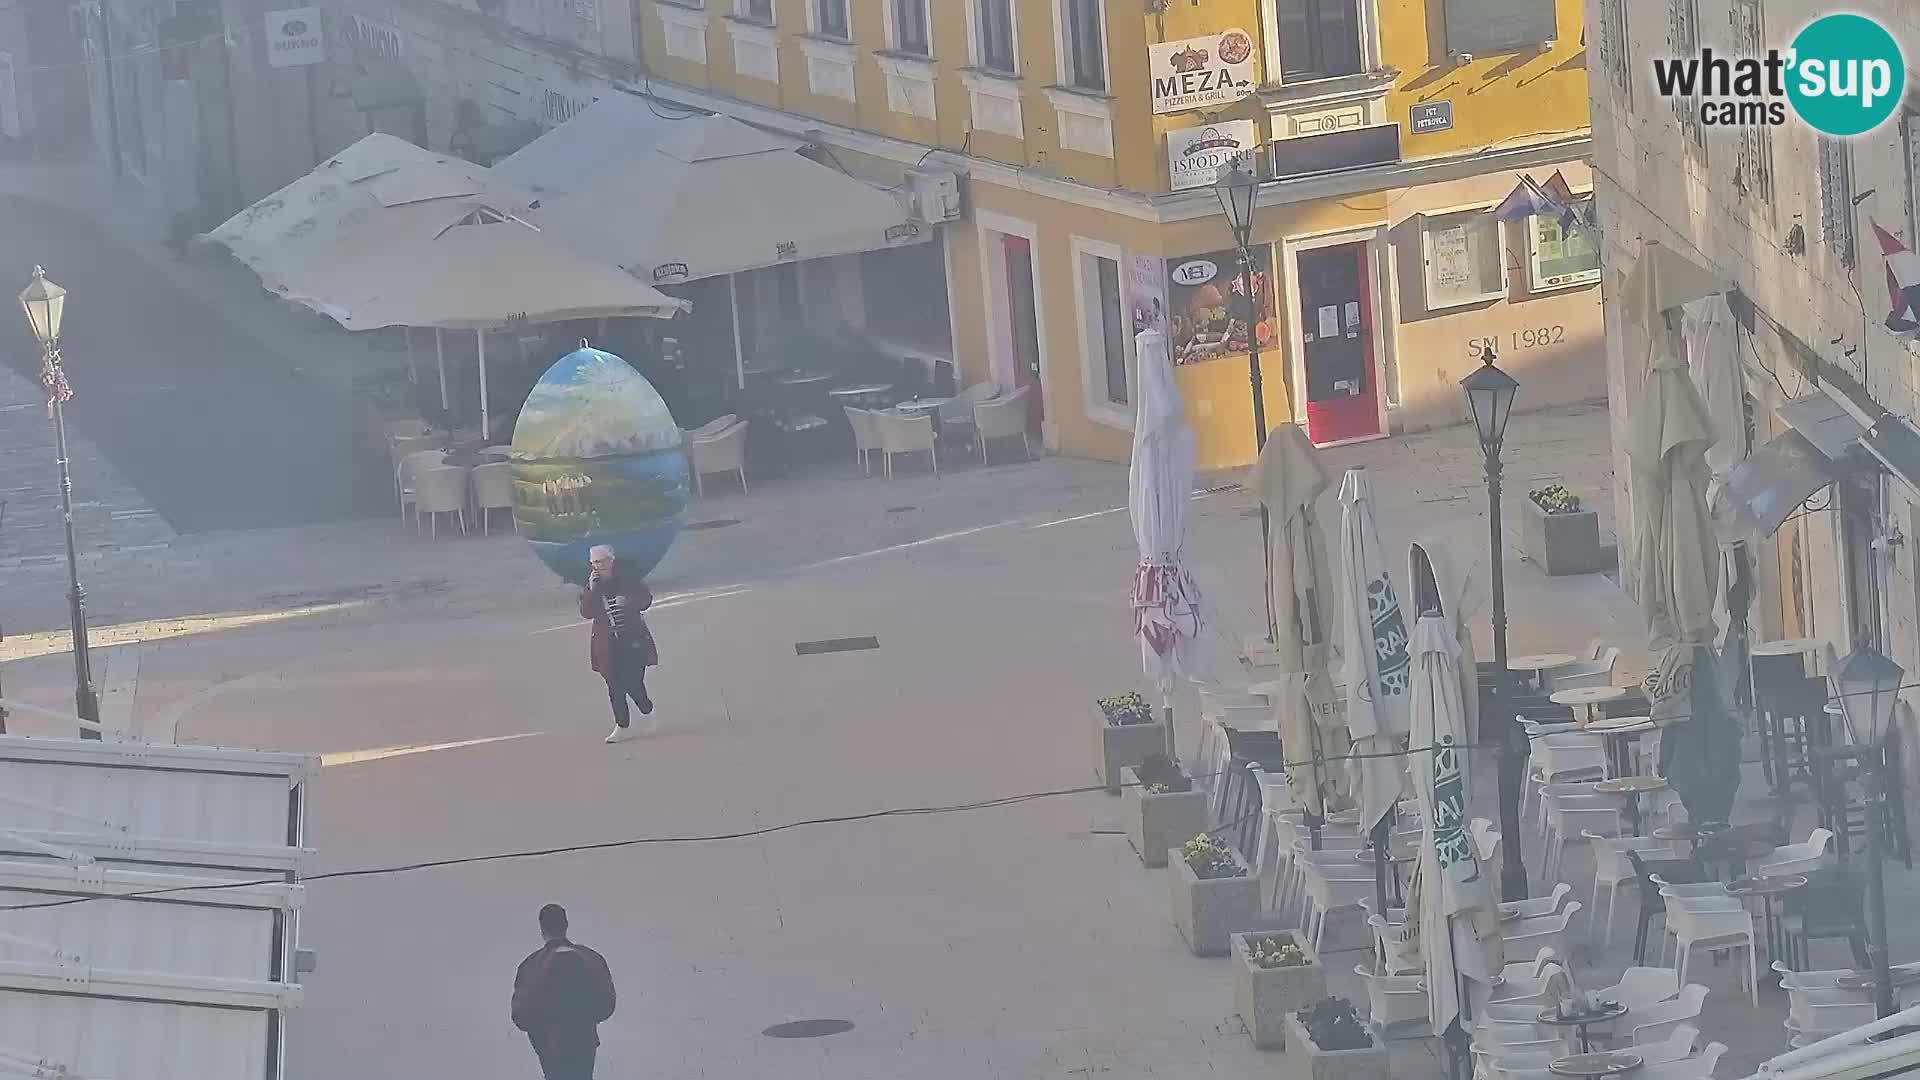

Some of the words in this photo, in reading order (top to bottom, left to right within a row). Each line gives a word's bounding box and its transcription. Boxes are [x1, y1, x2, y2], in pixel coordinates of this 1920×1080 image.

[1155, 68, 1234, 99] MEZA
[1164, 94, 1197, 107] PIZZERIA
[1197, 94, 1204, 102] &
[1204, 89, 1226, 101] GRILL
[1173, 154, 1220, 173] ISPOD
[1468, 335, 1499, 358] SM
[1512, 324, 1565, 351] 1982
